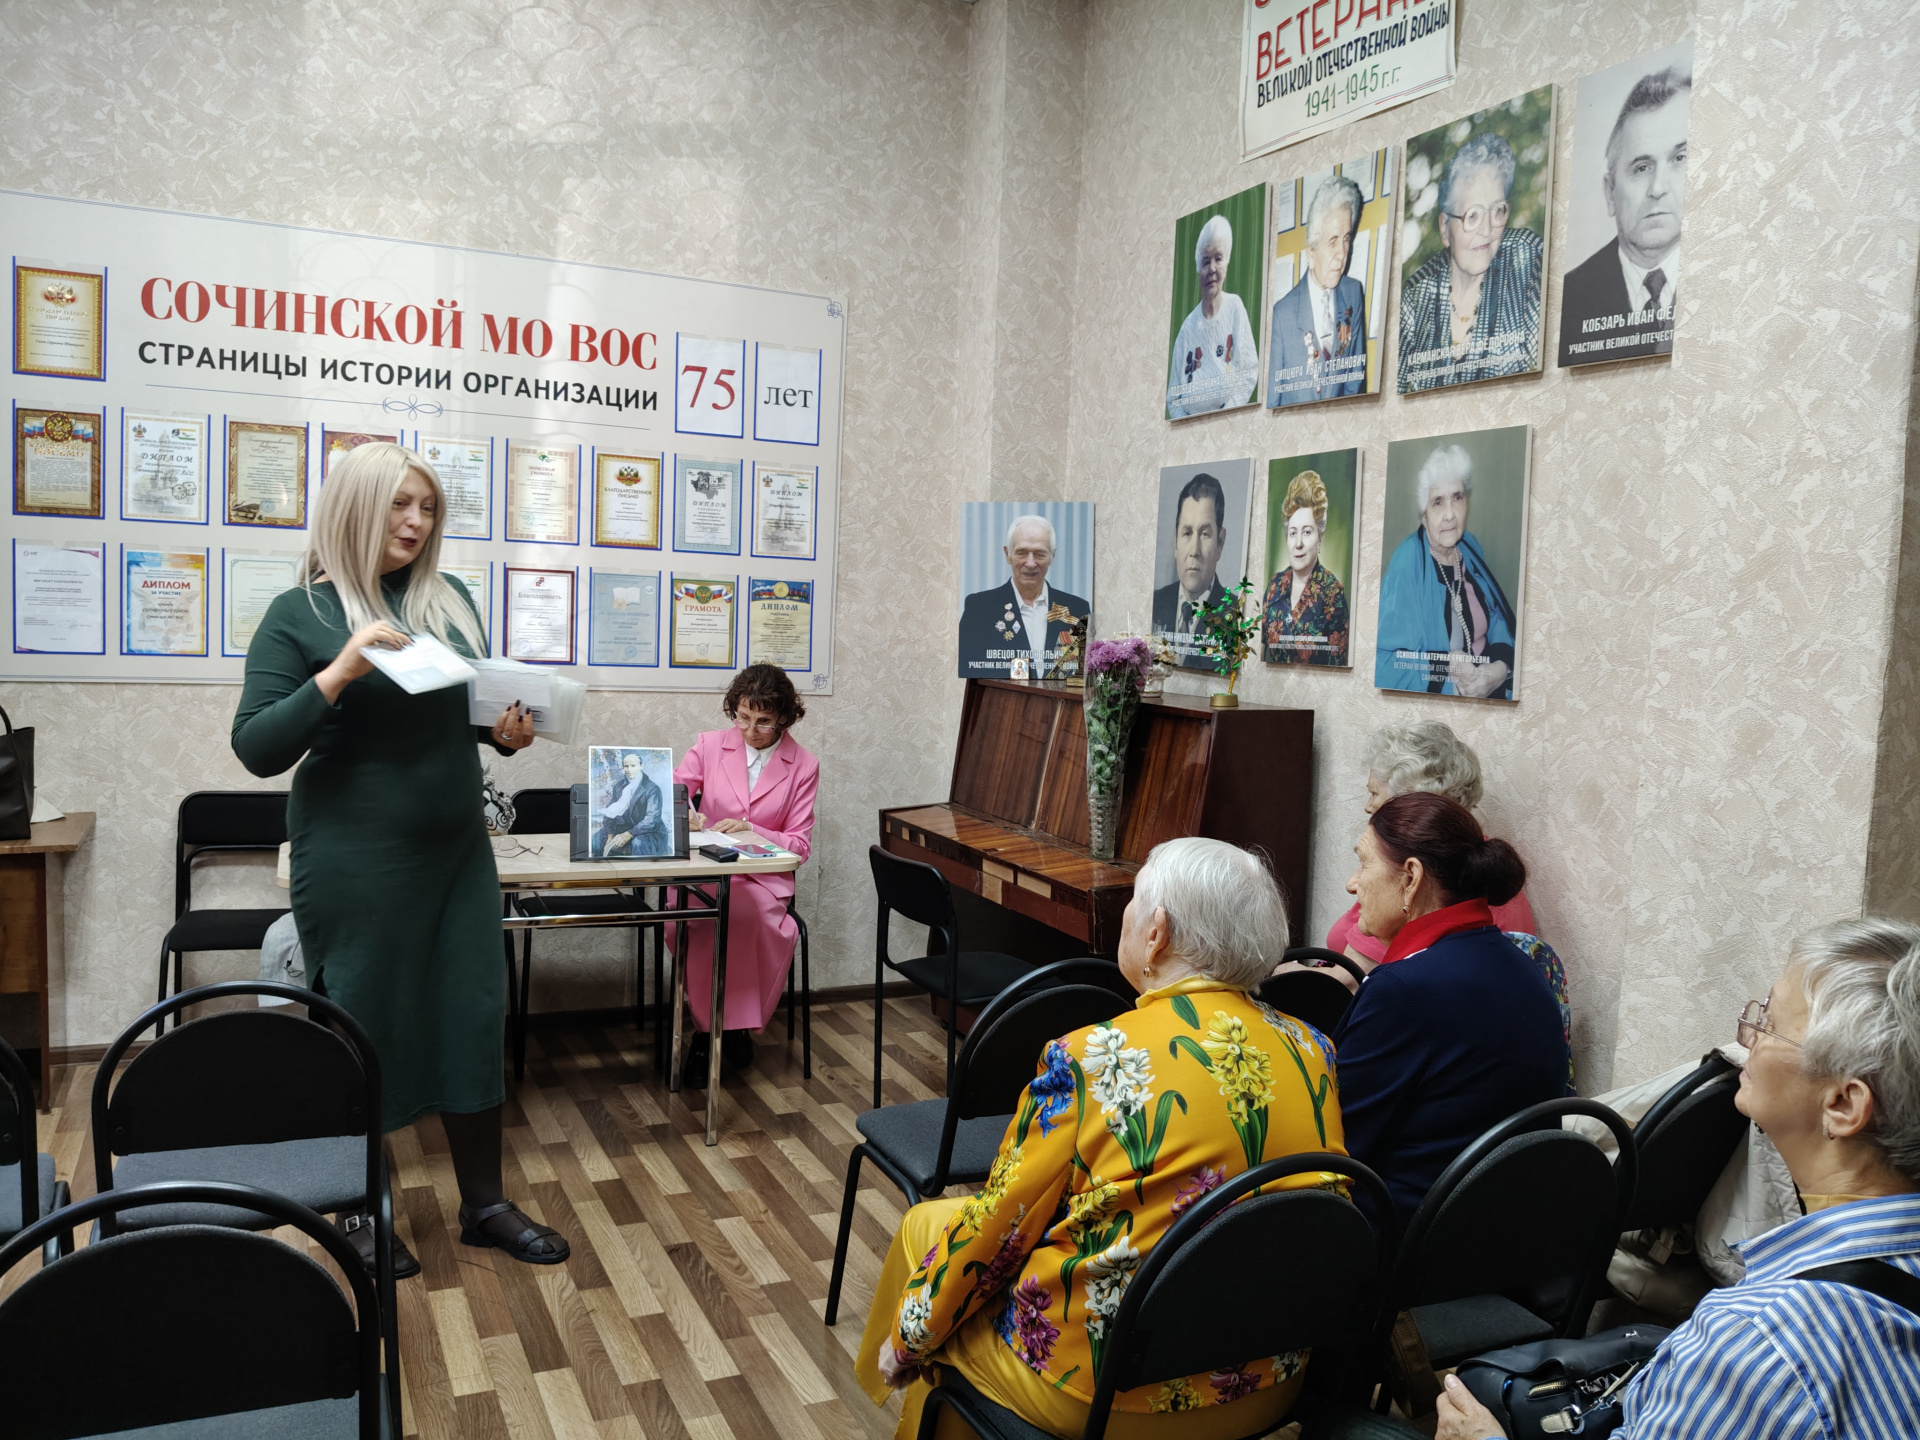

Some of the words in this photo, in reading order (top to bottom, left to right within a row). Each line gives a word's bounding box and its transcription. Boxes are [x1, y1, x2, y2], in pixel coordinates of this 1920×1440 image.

[1257, 57, 1313, 108] ВЕЛИКОЙ
[1315, 14, 1408, 82] ОТЕЧЕСТВЕННОЙ
[1409, 0, 1451, 42] ВОЙНЫ
[140, 277, 464, 351] СОЧИНСКОЙ
[480, 313, 553, 359] МО
[568, 323, 658, 371] ВОС
[1581, 313, 1626, 334] КОБЗАРЬ
[1627, 308, 1655, 326] ИВАН
[1456, 341, 1475, 359] ВЕРА
[1568, 339, 1605, 355] УЧАСТНИК
[1605, 332, 1641, 350] ВЕЛИКОЙ
[1324, 353, 1367, 373] СТЕПАНОВИЧ
[138, 341, 307, 381] СТРАНИЦЫ
[320, 358, 452, 391] ИСТОРИИ
[464, 371, 658, 412] ОРГАНИЗАЦИИ
[681, 365, 736, 411] 75
[763, 387, 814, 408] лет
[141, 580, 191, 590] ДИПЛОМ
[517, 592, 563, 600] Благодарность
[684, 604, 722, 613] ГРАМОТА
[760, 602, 799, 611] ДИПЛОМ
[986, 649, 1016, 660] ШВЕЦОВ
[1016, 649, 1039, 660] ТИХОН
[1396, 650, 1419, 660] ОСИПОВА
[1420, 651, 1450, 661] ЕКАТЕРИНА
[1452, 653, 1491, 664] ГРИГОРЬЕВНА
[968, 661, 995, 669] УЧАСТНИК
